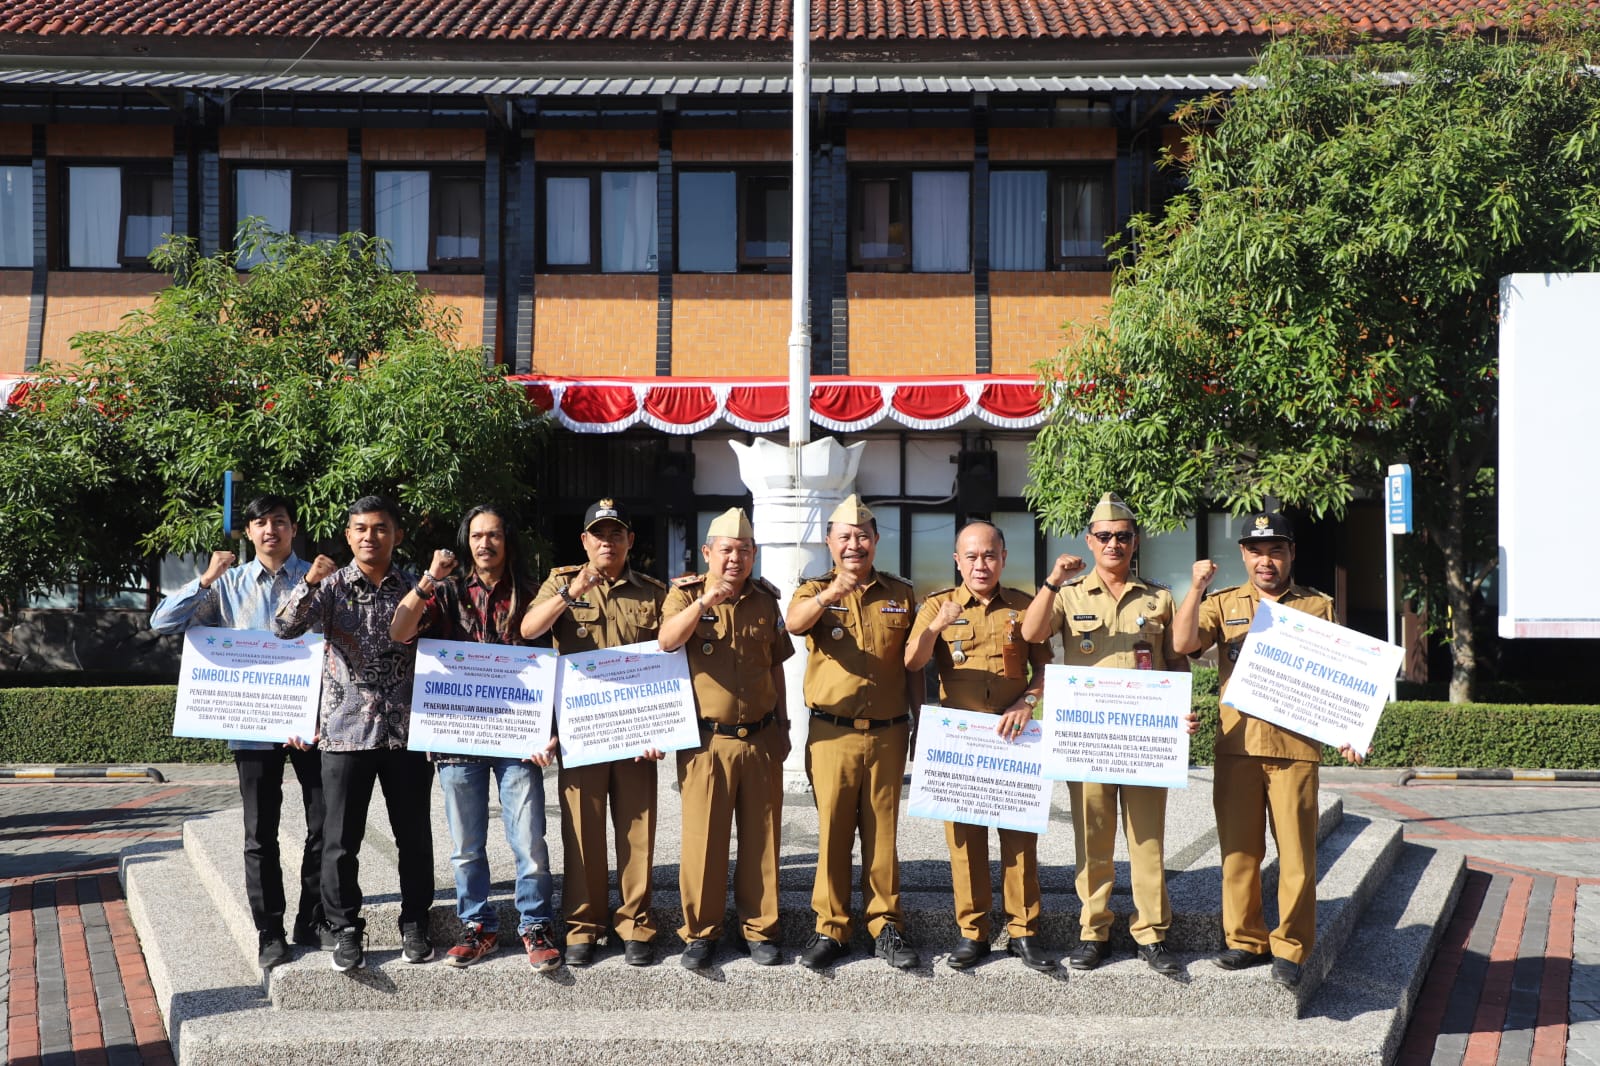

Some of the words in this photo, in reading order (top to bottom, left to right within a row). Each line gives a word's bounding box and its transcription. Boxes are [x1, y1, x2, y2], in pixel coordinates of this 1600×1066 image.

[192, 668, 240, 683] SIMBOLIS
[242, 671, 310, 688] PENYERAHAN
[1254, 641, 1305, 670] SIMBOLIS
[1304, 660, 1378, 698] PENYERAHAN
[425, 681, 473, 697] SIMBOLIS
[475, 685, 543, 702] PENYERAHAN
[565, 690, 612, 710] SIMBOLIS
[614, 679, 680, 702] PENYERAHAN
[424, 702, 450, 710] PENERIMA
[451, 704, 475, 712] BANTUAN
[516, 709, 540, 717] BERMUTU
[568, 714, 594, 725] PENERIMA
[594, 710, 618, 720] BANTUAN
[619, 708, 636, 716] BAHAN
[637, 704, 658, 714] BACAAN
[658, 700, 683, 710] BERMUTU
[1056, 709, 1105, 724] SIMBOLIS
[1108, 712, 1178, 729] PENYERAHAN
[1055, 730, 1082, 738] PENERIMA
[1083, 732, 1108, 740] BANTUAN
[1152, 736, 1177, 744] BERMUTU
[926, 748, 974, 767] SIMBOLIS
[925, 769, 951, 779] PENERIMA
[952, 773, 976, 782] BANTUAN
[976, 776, 994, 785] BAHAN
[995, 779, 1016, 788] BACAAN
[1017, 782, 1041, 791] BERMUTU
